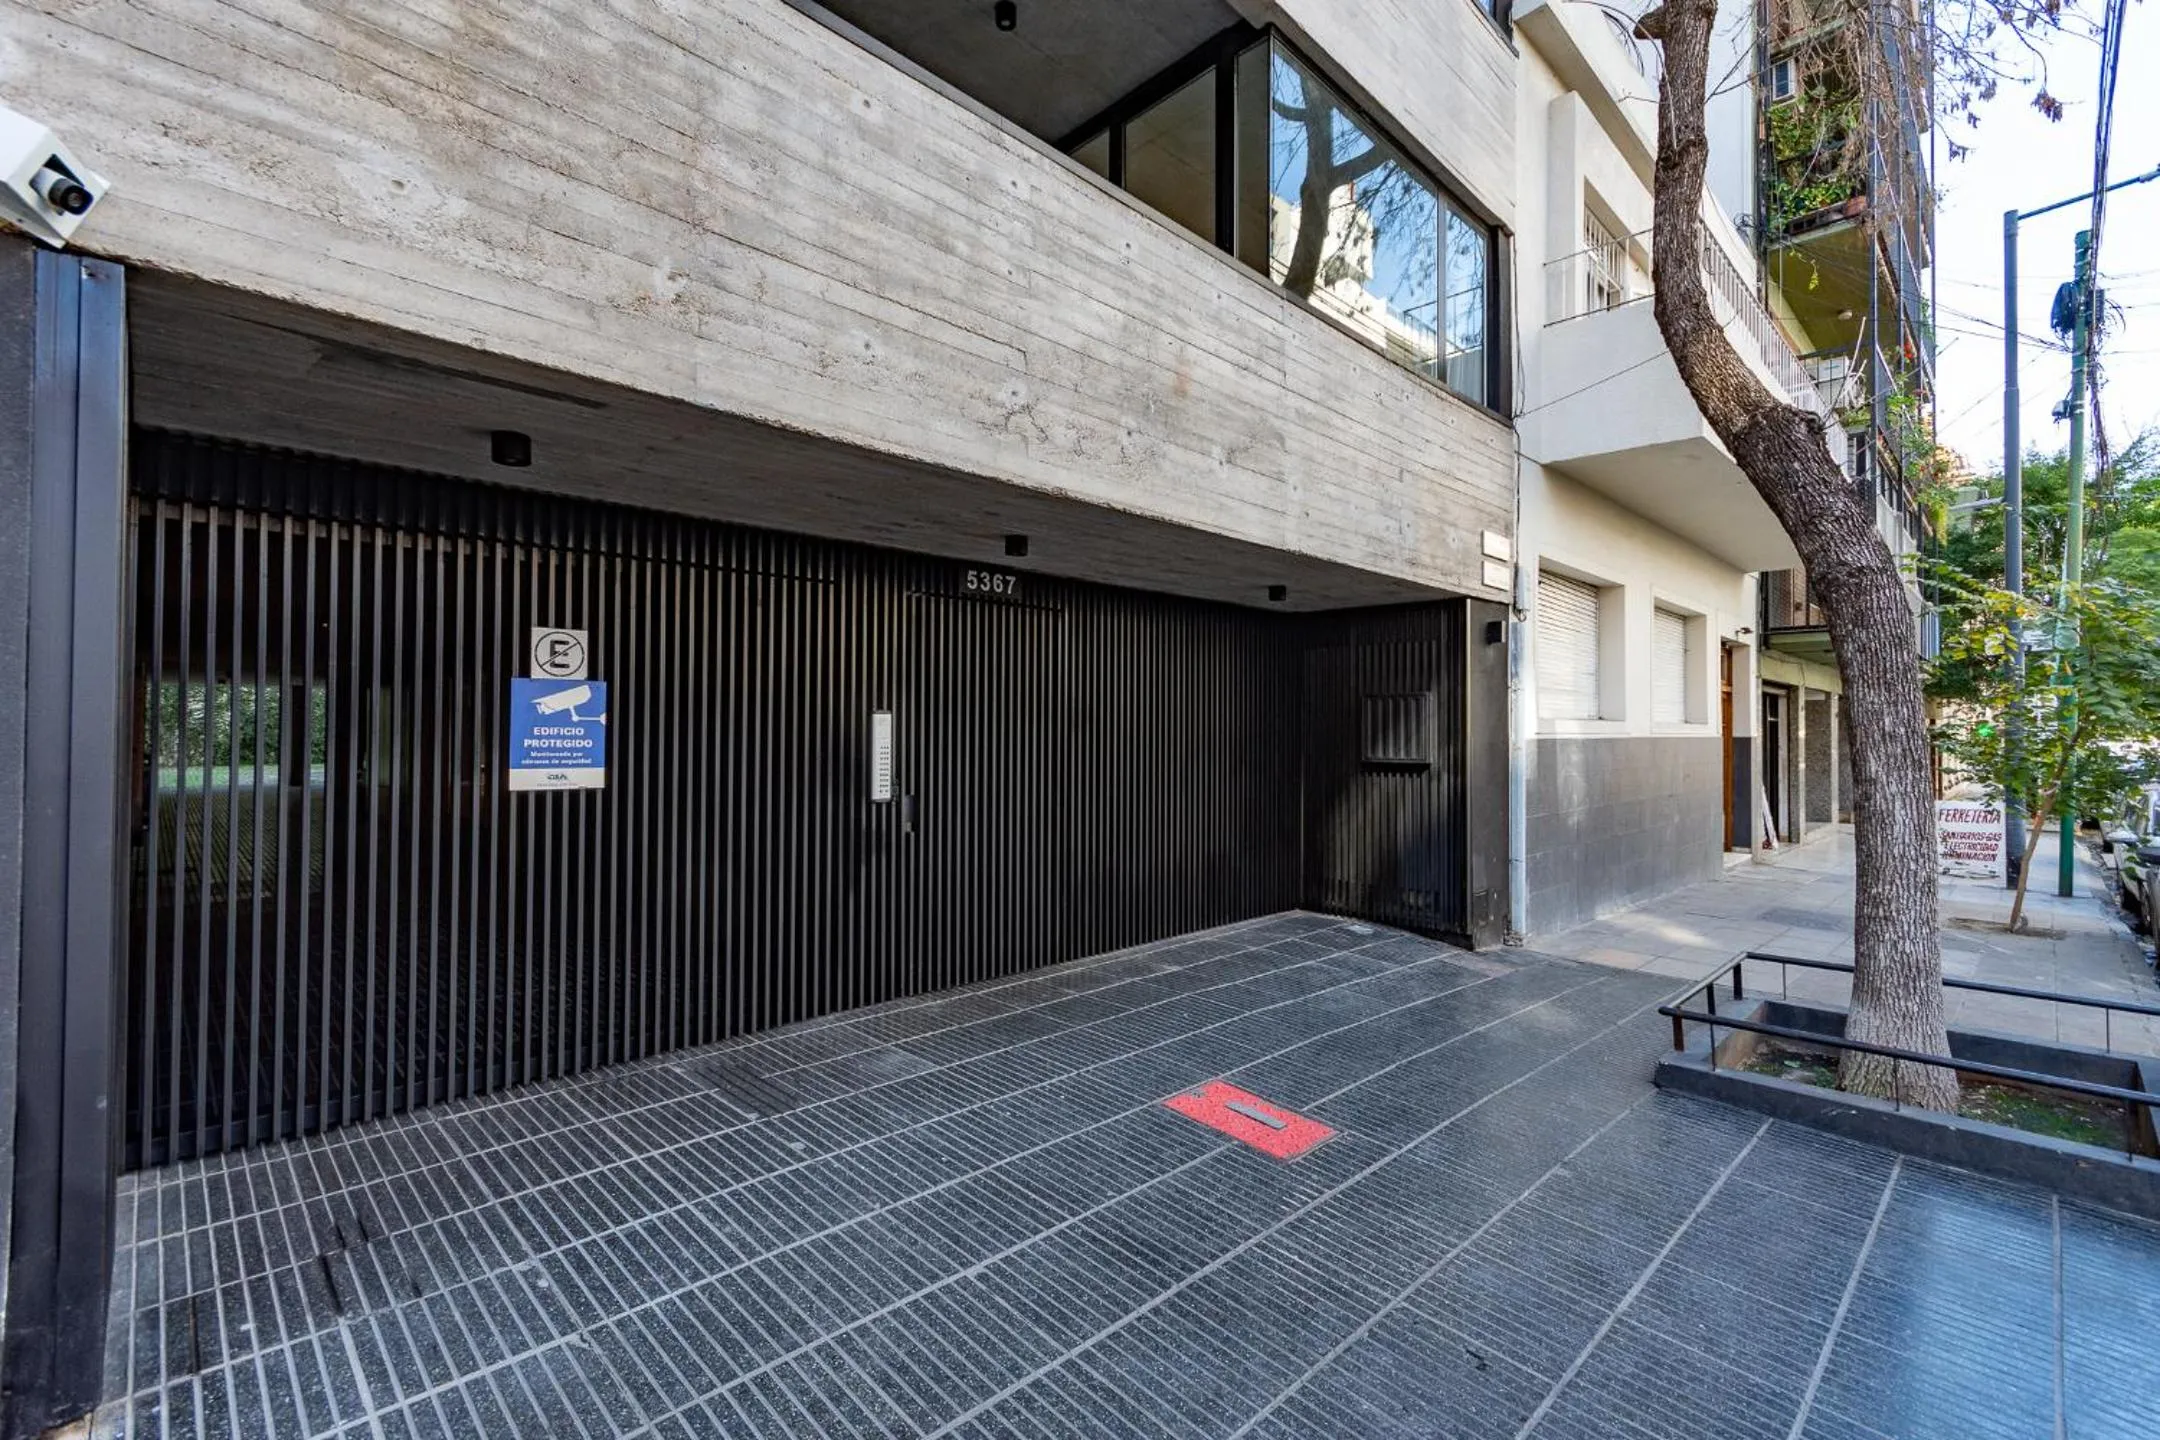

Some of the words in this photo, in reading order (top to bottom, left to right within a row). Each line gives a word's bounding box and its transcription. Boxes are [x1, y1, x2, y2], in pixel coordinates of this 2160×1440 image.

[967, 570, 1016, 594] 5367
[550, 640, 570, 667] E
[533, 727, 584, 736] EDIFICIO
[523, 739, 593, 748] PROTEGIDO
